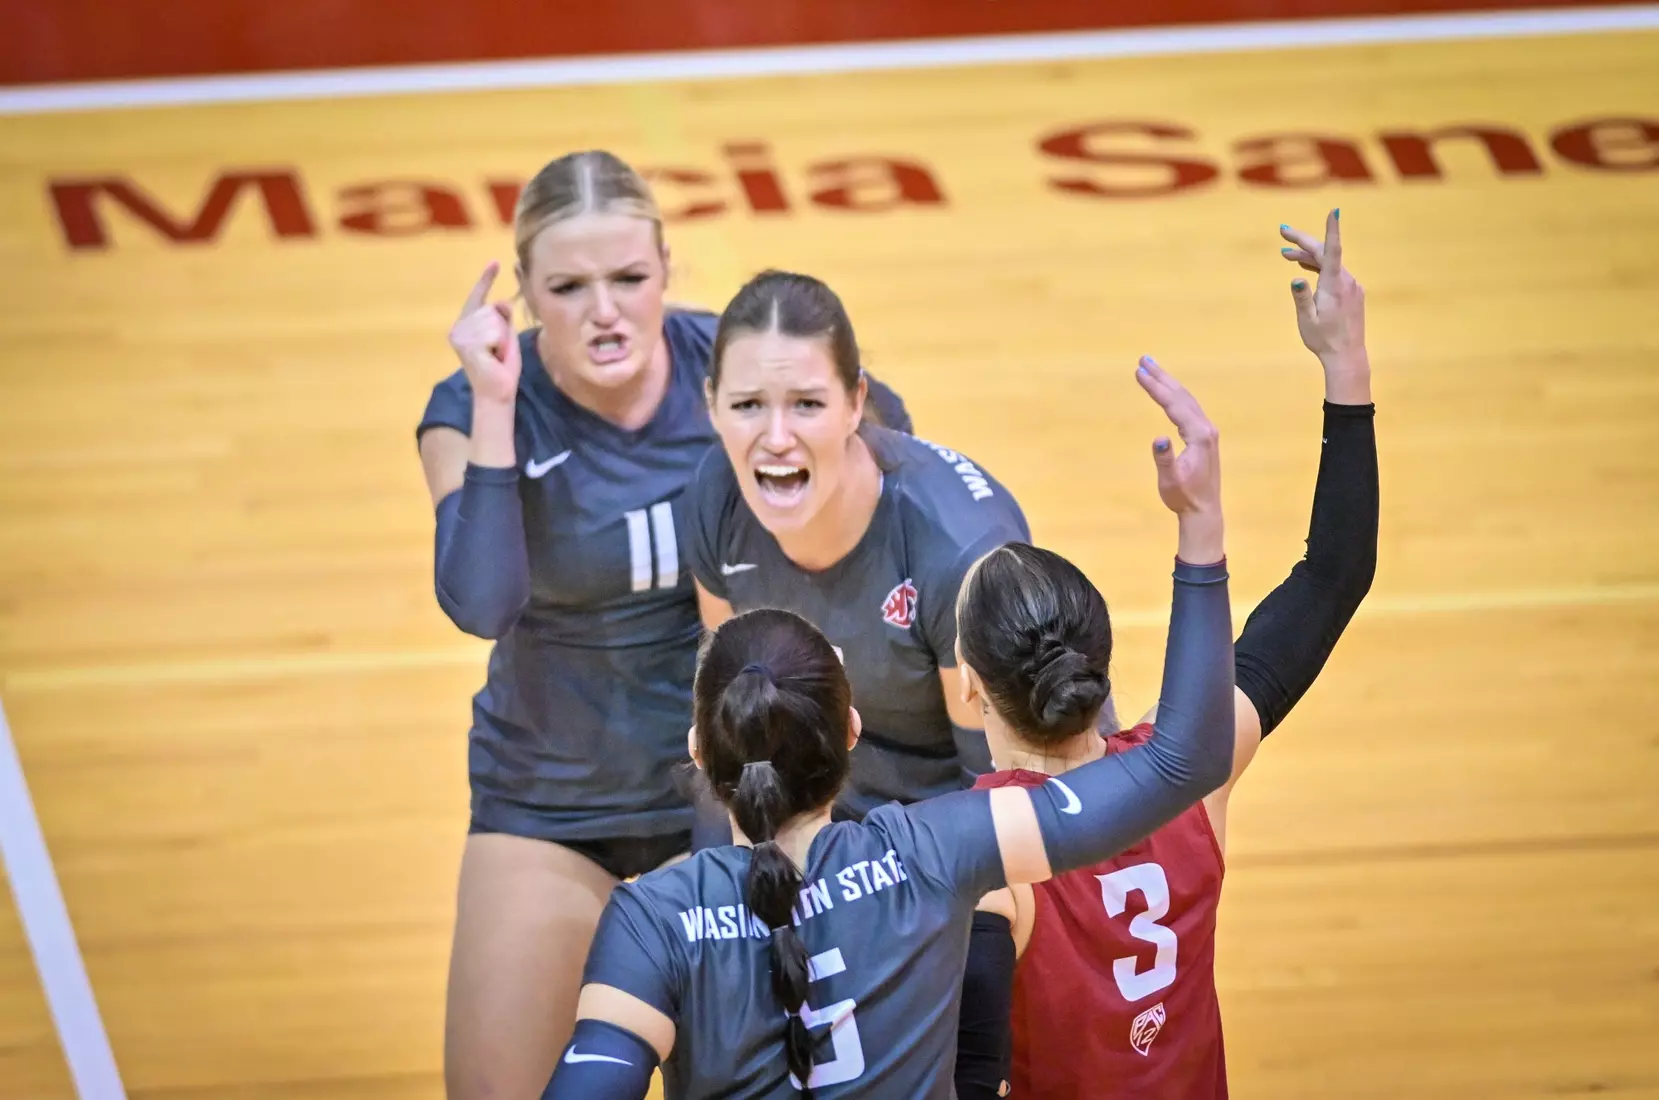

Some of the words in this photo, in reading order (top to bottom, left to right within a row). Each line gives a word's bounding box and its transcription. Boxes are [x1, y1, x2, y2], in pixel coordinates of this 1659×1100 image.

[1036, 116, 1659, 199] Sane
[624, 501, 679, 592] 11
[678, 877, 833, 943] WASINON
[1093, 862, 1178, 1002] 3
[1133, 1004, 1165, 1037] PAC
[1134, 1027, 1157, 1047] 12
